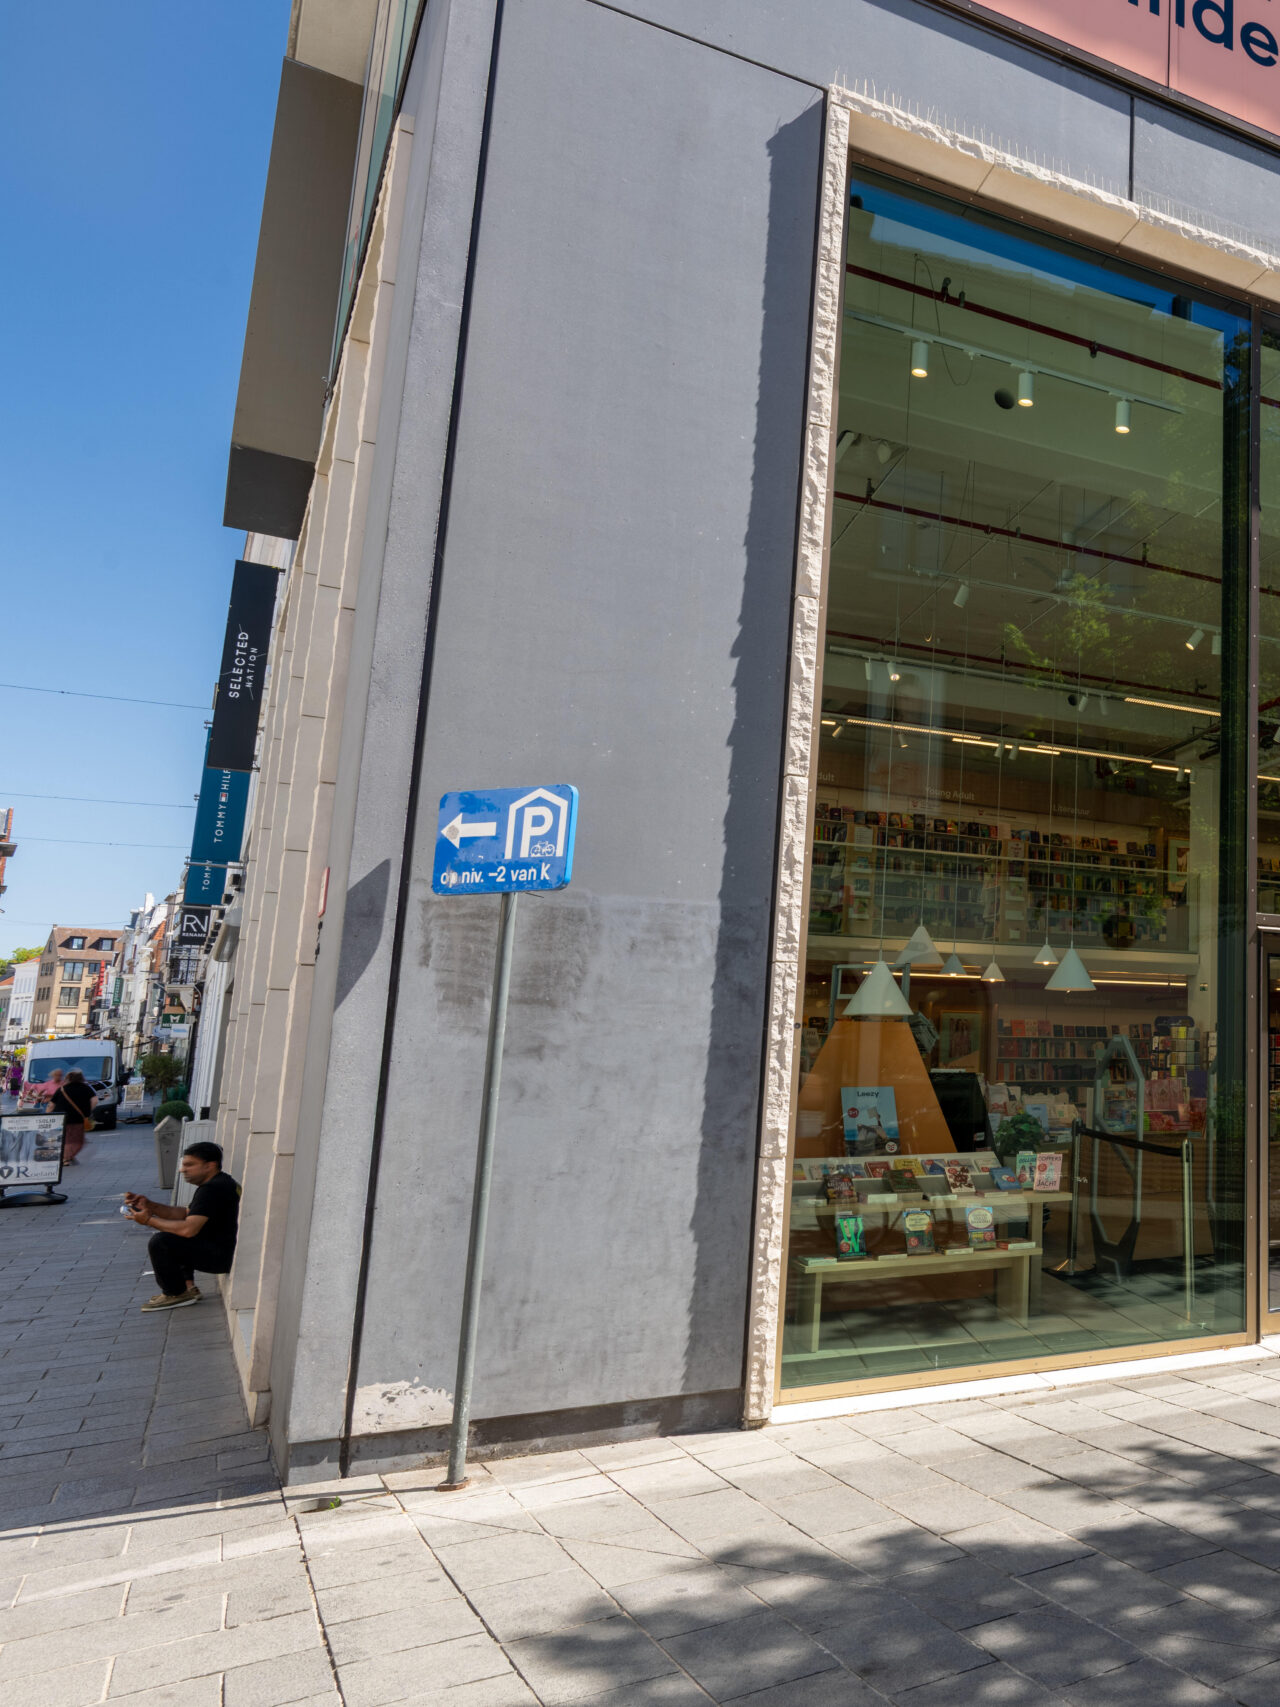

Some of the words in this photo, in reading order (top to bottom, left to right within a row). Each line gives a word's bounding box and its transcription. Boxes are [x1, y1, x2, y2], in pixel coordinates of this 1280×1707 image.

[228, 631, 249, 698] SELECTED
[245, 647, 258, 688] NATION
[213, 804, 227, 844] TOMMY
[462, 868, 484, 883] niv.
[488, 866, 506, 882] -2
[510, 867, 536, 881] van
[541, 862, 550, 881] K
